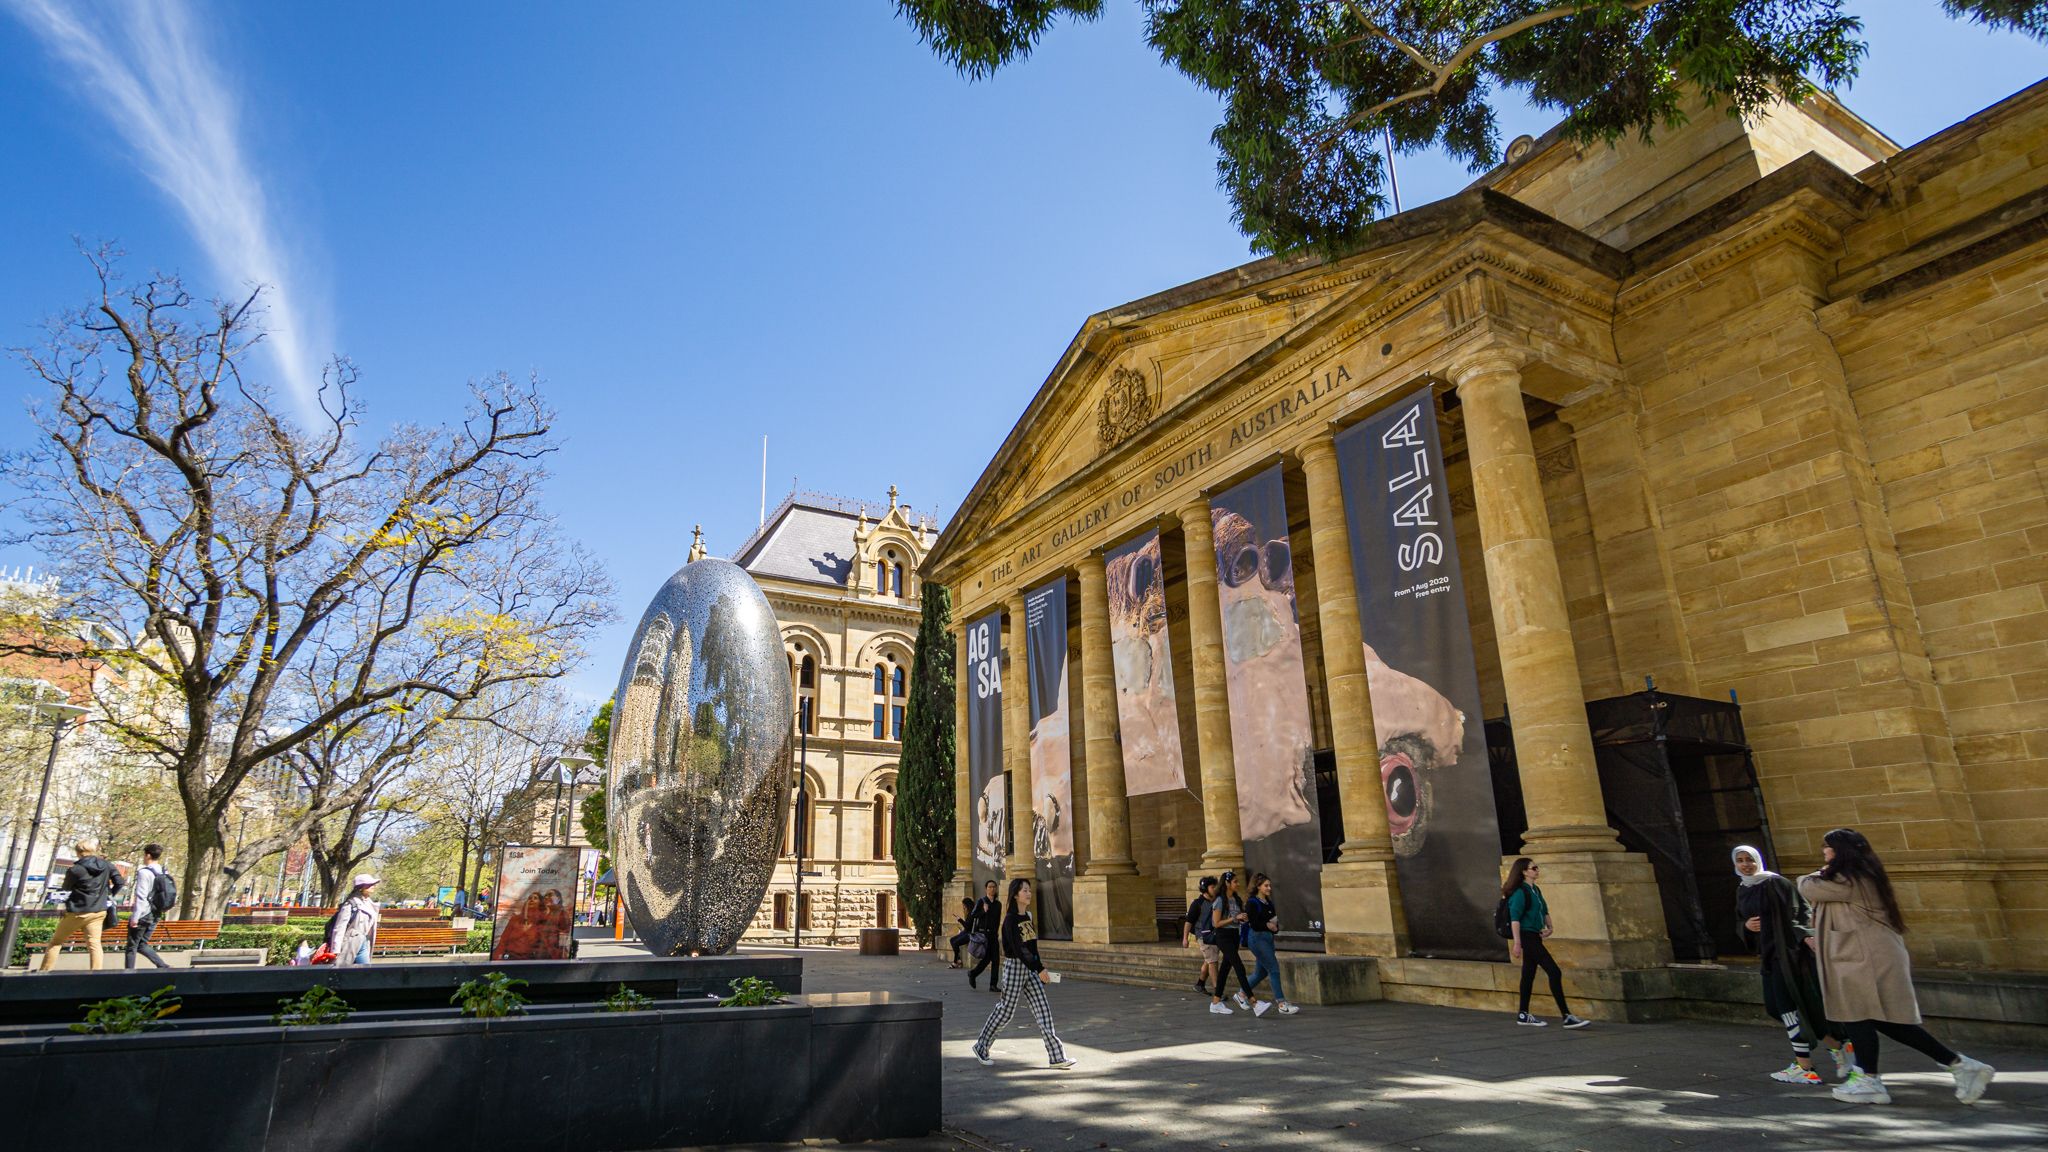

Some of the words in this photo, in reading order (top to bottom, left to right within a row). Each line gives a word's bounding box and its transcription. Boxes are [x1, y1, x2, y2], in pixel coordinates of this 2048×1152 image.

[991, 560, 1013, 583] THE
[1021, 543, 1043, 567] ART
[1052, 503, 1109, 548] GALLERY
[1122, 484, 1142, 507] OF
[1154, 443, 1213, 490] SOUTH
[1229, 365, 1352, 448] AUSTRALIA
[1382, 404, 1443, 572] SALA
[1394, 589, 1410, 598] From
[1415, 583, 1428, 591] Aug
[1429, 576, 1449, 586] 2020
[1415, 590, 1430, 599] Free
[1430, 585, 1450, 593] entry
[968, 622, 989, 666] AG
[977, 656, 1002, 699] SA
